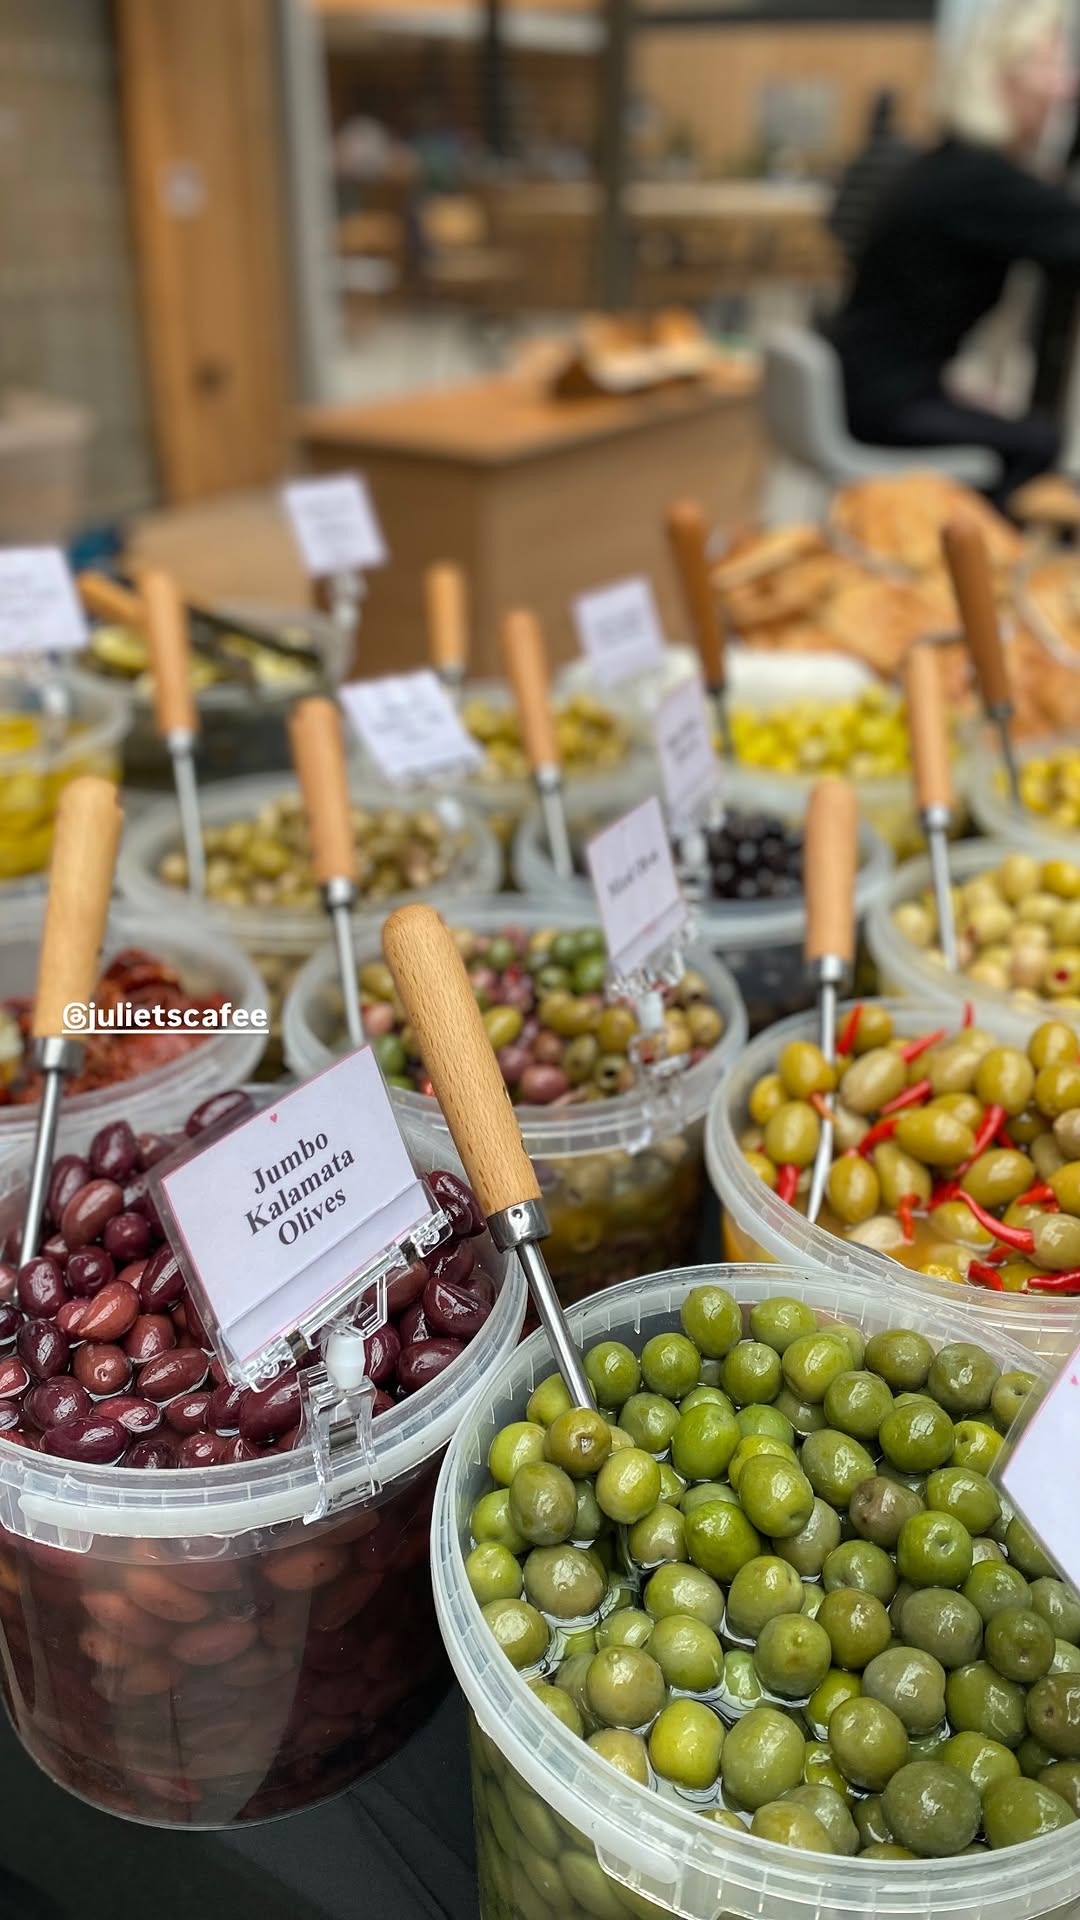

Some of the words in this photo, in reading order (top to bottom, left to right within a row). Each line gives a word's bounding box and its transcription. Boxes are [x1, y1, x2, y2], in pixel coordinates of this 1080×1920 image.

[244, 1149, 355, 1236] Kalamata
[252, 1133, 328, 1194] Jumbo
[278, 1188, 346, 1245] Olives
